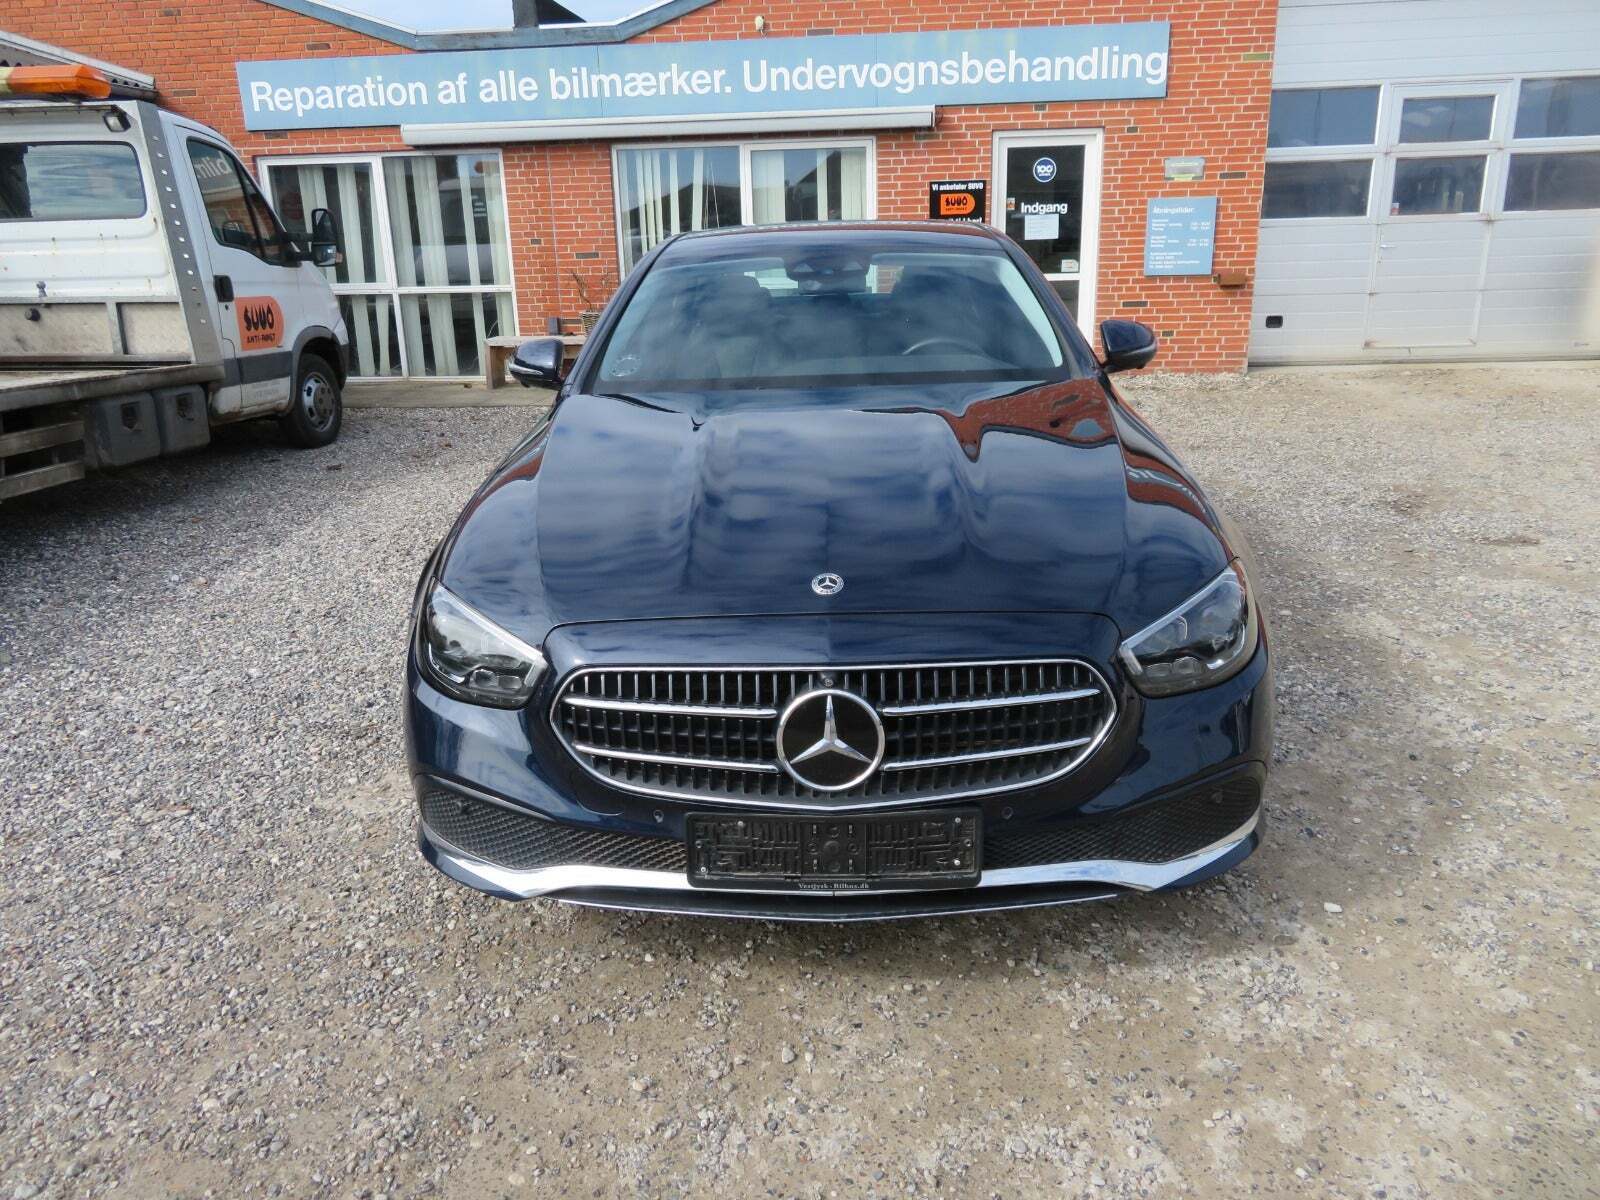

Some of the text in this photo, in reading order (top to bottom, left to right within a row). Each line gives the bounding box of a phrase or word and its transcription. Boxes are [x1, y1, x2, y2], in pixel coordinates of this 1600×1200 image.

[250, 46, 1169, 118] Reparation af alle bilmærker. Undervognsbehandling
[939, 183, 967, 191] anbefaler
[967, 182, 984, 190] SUVO
[1020, 202, 1068, 215] Indgang
